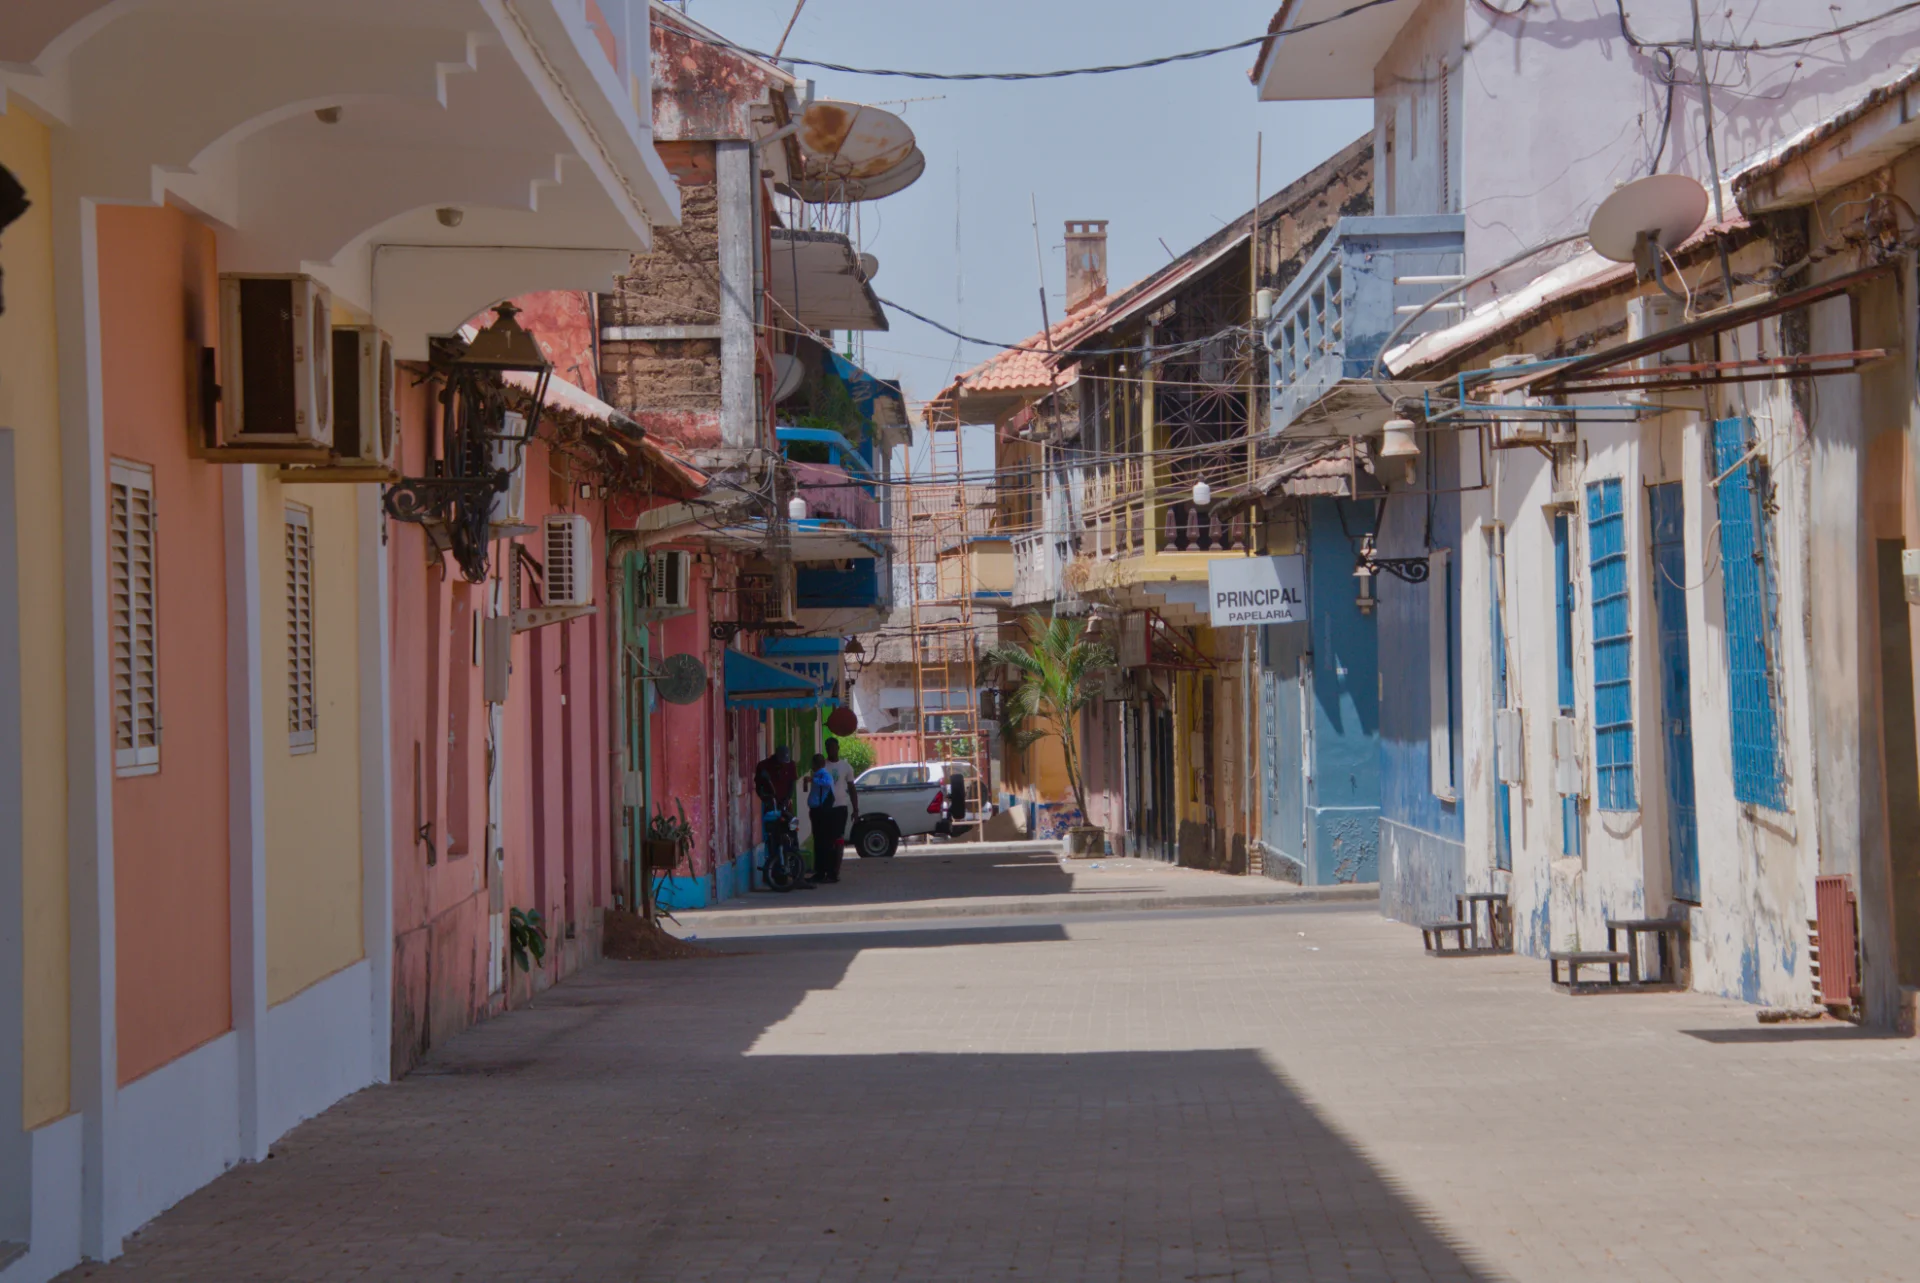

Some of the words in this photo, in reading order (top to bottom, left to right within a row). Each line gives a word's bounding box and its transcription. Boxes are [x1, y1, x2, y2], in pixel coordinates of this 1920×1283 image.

[1217, 588, 1302, 608] PRINCIPAL
[1229, 610, 1292, 621] PAPELARIA
[774, 662, 834, 690] TEL
